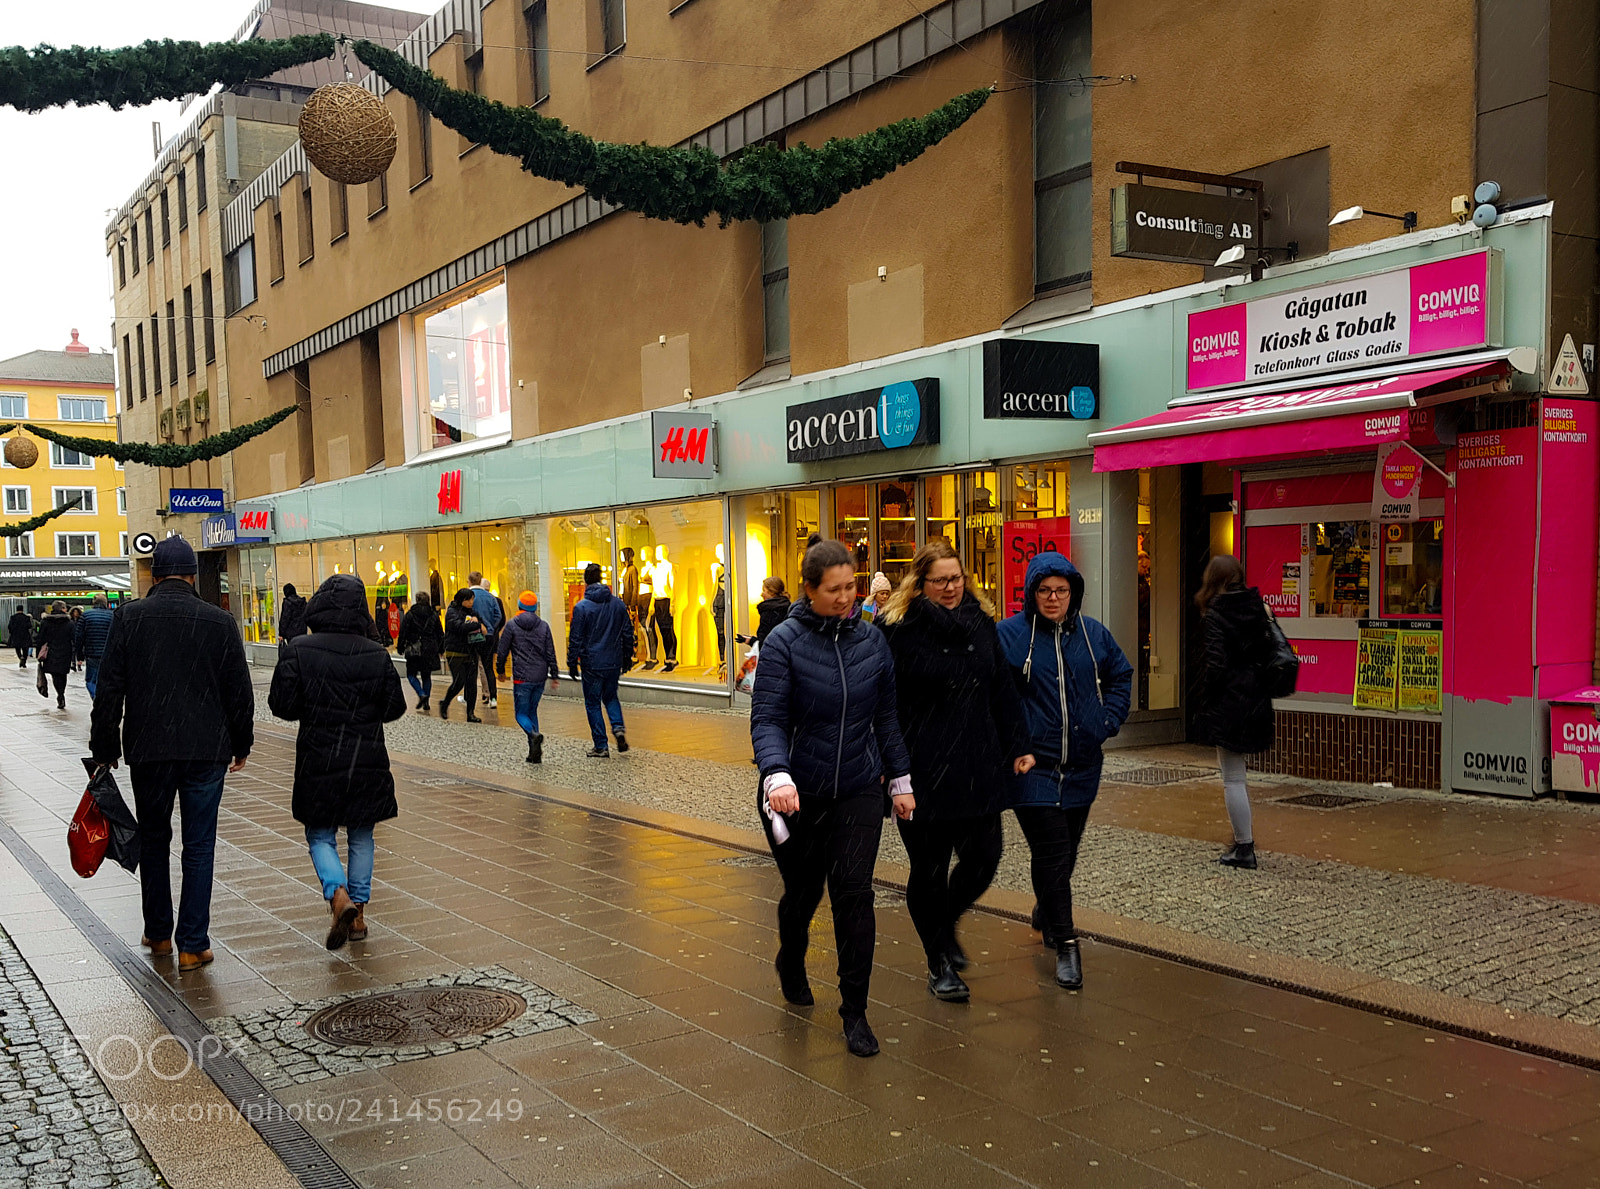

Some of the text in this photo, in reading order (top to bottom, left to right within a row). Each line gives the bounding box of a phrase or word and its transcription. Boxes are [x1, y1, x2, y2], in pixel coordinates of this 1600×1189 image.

[1135, 211, 1253, 240] Consulting AB
[1284, 289, 1368, 320] Gågatan
[1418, 283, 1480, 312] COMVIQ
[1192, 330, 1240, 353] COMVIQ
[1259, 311, 1397, 354] Kiosk & Tobak
[1254, 339, 1403, 376] Telefonkort Glass Godis
[1002, 390, 1075, 412] accent
[788, 394, 894, 452] accent
[1364, 415, 1401, 430] COMVIQ
[1544, 408, 1574, 419] SVERIGES
[1544, 420, 1577, 431] BILLIGASTE
[660, 426, 709, 464] H&M
[1458, 434, 1501, 448] SVERIGES
[1543, 431, 1588, 444] KONTANTKORT!
[1458, 455, 1524, 470] KONTANTKORT!
[1459, 445, 1507, 459] BILLIGASTE
[436, 469, 461, 515] H&M
[1382, 503, 1412, 514] COMVIQ
[239, 511, 268, 531] H&M
[1011, 533, 1058, 564] Sale
[0, 569, 88, 578] AKADEMIBOKHANDELN
[1262, 594, 1299, 606] COMVIQ
[1562, 723, 1600, 742] COM
[1463, 751, 1527, 775] COMVIQ
